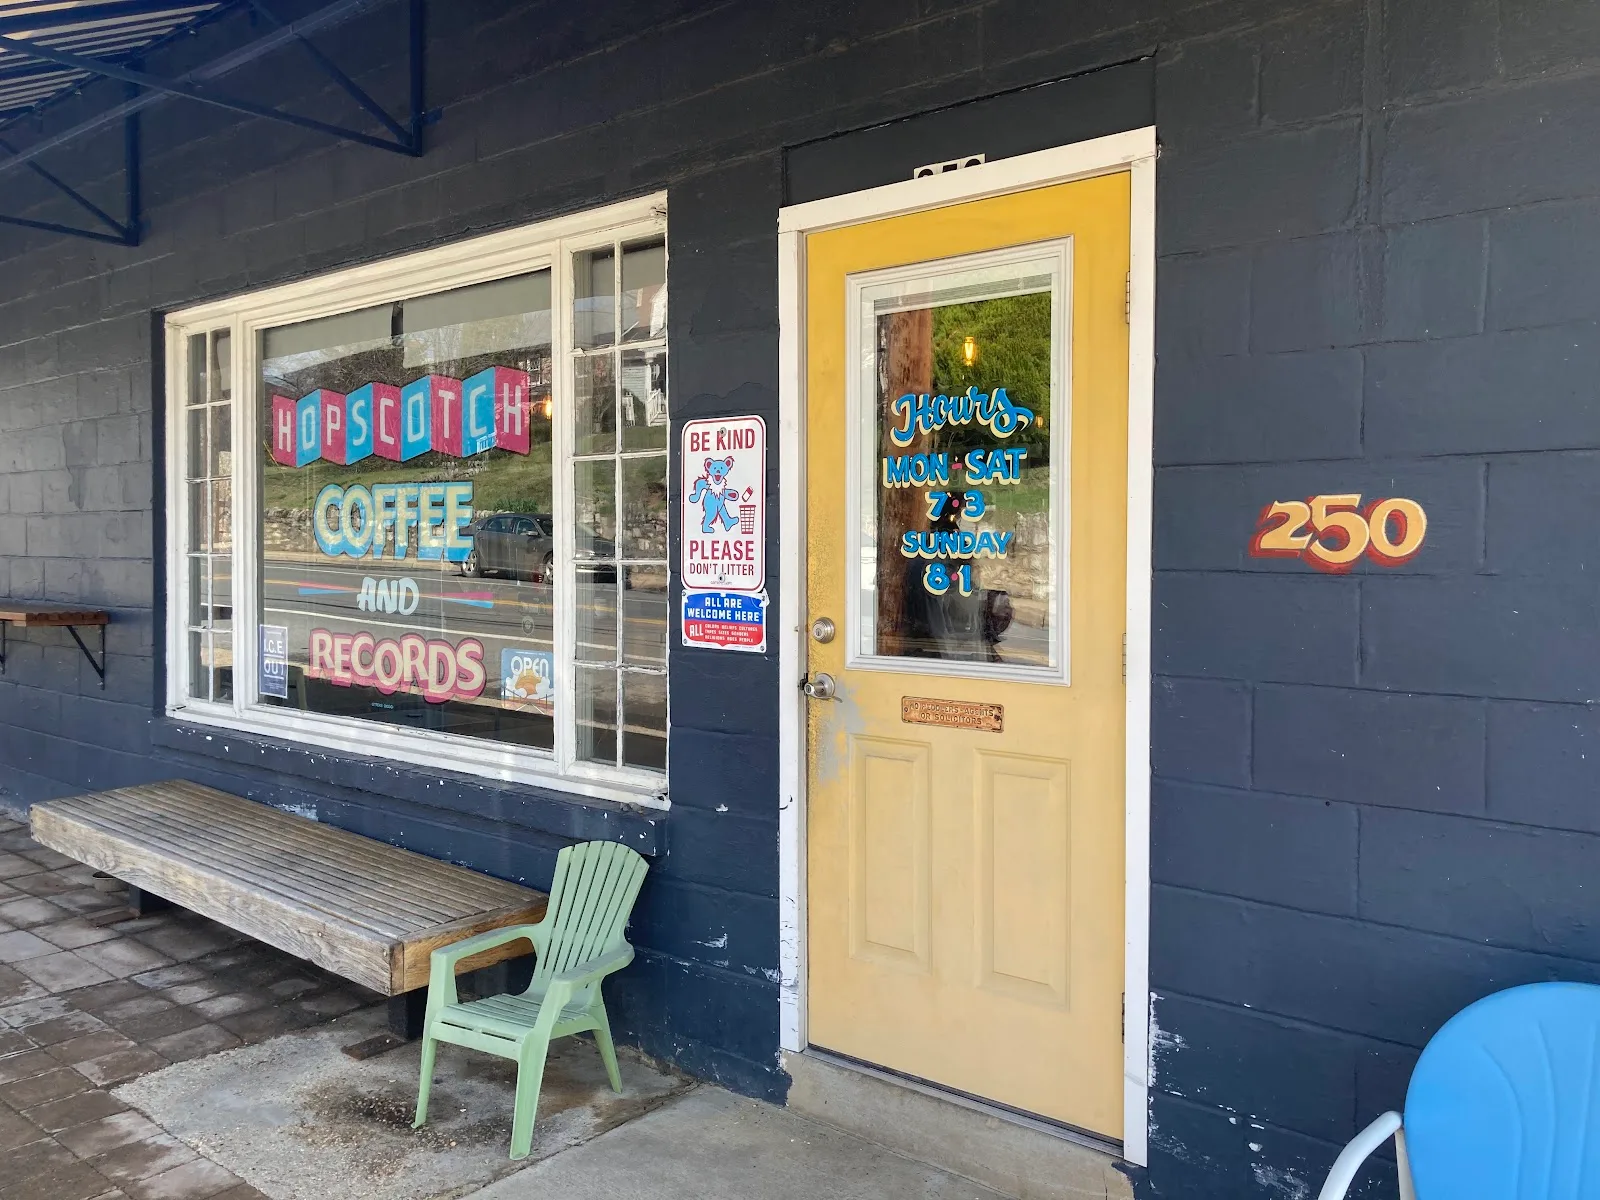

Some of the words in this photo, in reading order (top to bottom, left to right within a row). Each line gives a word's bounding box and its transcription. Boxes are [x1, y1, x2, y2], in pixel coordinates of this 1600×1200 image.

[278, 383, 522, 453] HOPSCOTCH
[890, 385, 1034, 447] Hours
[690, 431, 710, 452] BE
[717, 428, 755, 451] KIND
[314, 481, 474, 561] COFFEE
[901, 530, 1013, 559] SUNDAY
[1249, 493, 1428, 575] 250
[689, 540, 755, 562] PLEASE
[690, 563, 718, 575] DON'T
[721, 563, 754, 576] LITTER
[356, 576, 420, 616] AND
[704, 597, 722, 608] ALL
[723, 598, 742, 609] ARE
[687, 608, 732, 620] WELCOME
[735, 611, 760, 622] HERE
[689, 624, 704, 637] ALL
[263, 659, 285, 676] OUT
[309, 628, 487, 704] RECORDS
[510, 655, 549, 680] OPEN
[920, 712, 931, 720] OR
[934, 713, 982, 725] SOLICITORS
